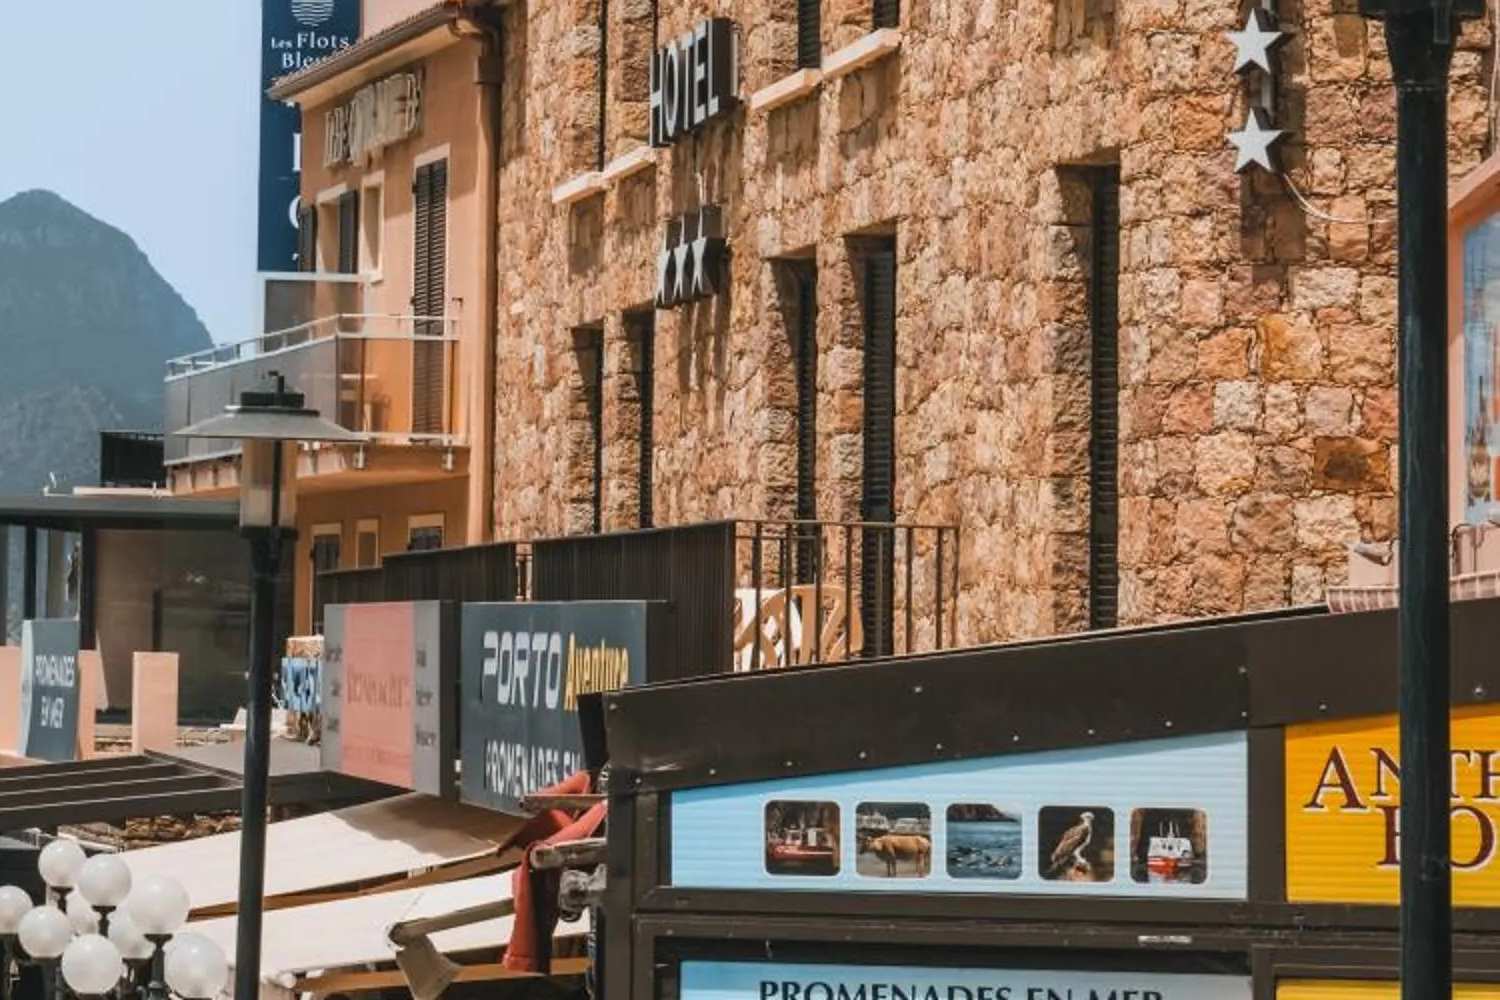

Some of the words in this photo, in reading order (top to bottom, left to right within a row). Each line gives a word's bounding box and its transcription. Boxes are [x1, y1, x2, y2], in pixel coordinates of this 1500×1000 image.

[282, 51, 329, 69] Ble
[297, 31, 350, 49] Flots
[649, 17, 720, 148] HOTEL
[482, 630, 562, 710] PORTO
[563, 632, 630, 712] Aventure
[485, 738, 560, 799] PROMENADES
